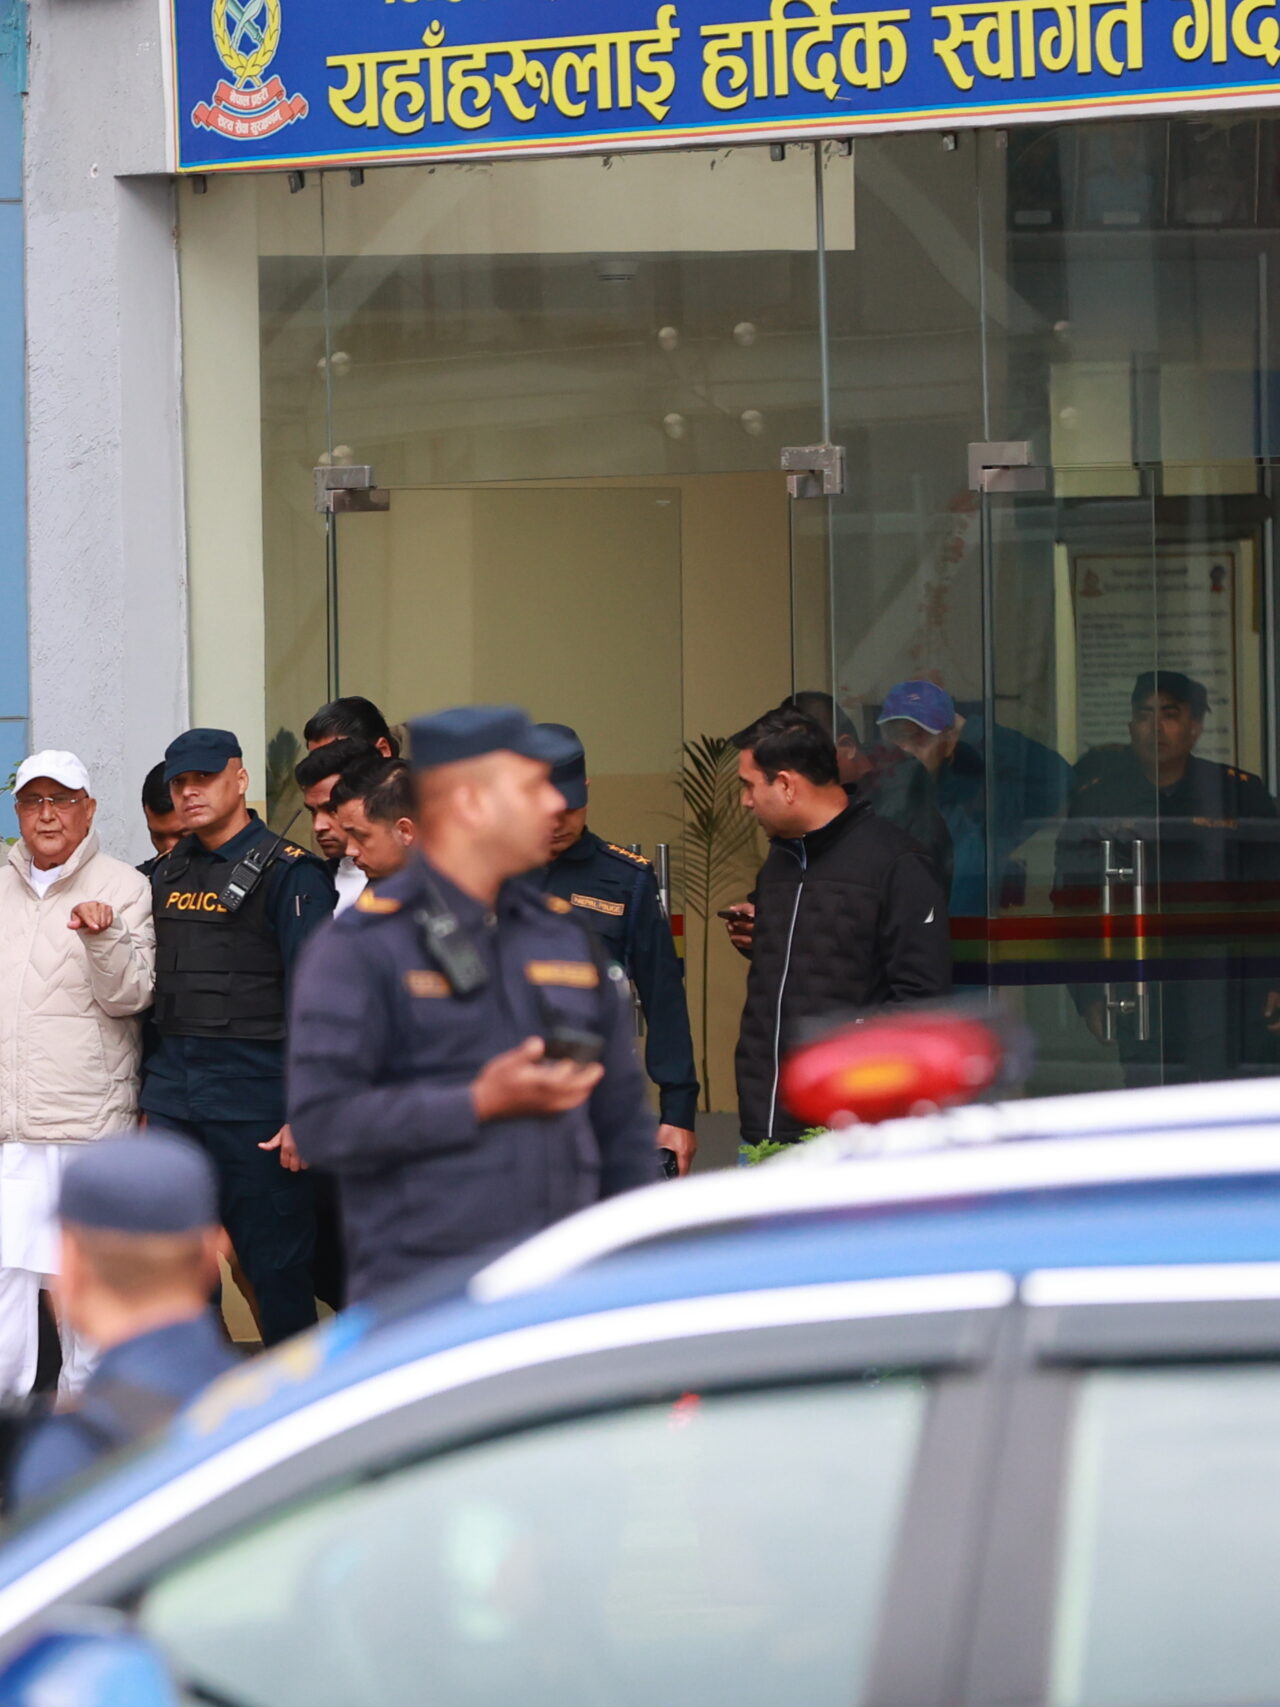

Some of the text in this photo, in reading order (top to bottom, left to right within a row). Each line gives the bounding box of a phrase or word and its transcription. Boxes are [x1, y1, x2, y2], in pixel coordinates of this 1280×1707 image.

[327, 4, 679, 135] यहाँहरुलाई
[700, 0, 911, 110] हार्दिक
[931, 0, 1147, 90] स्वागत
